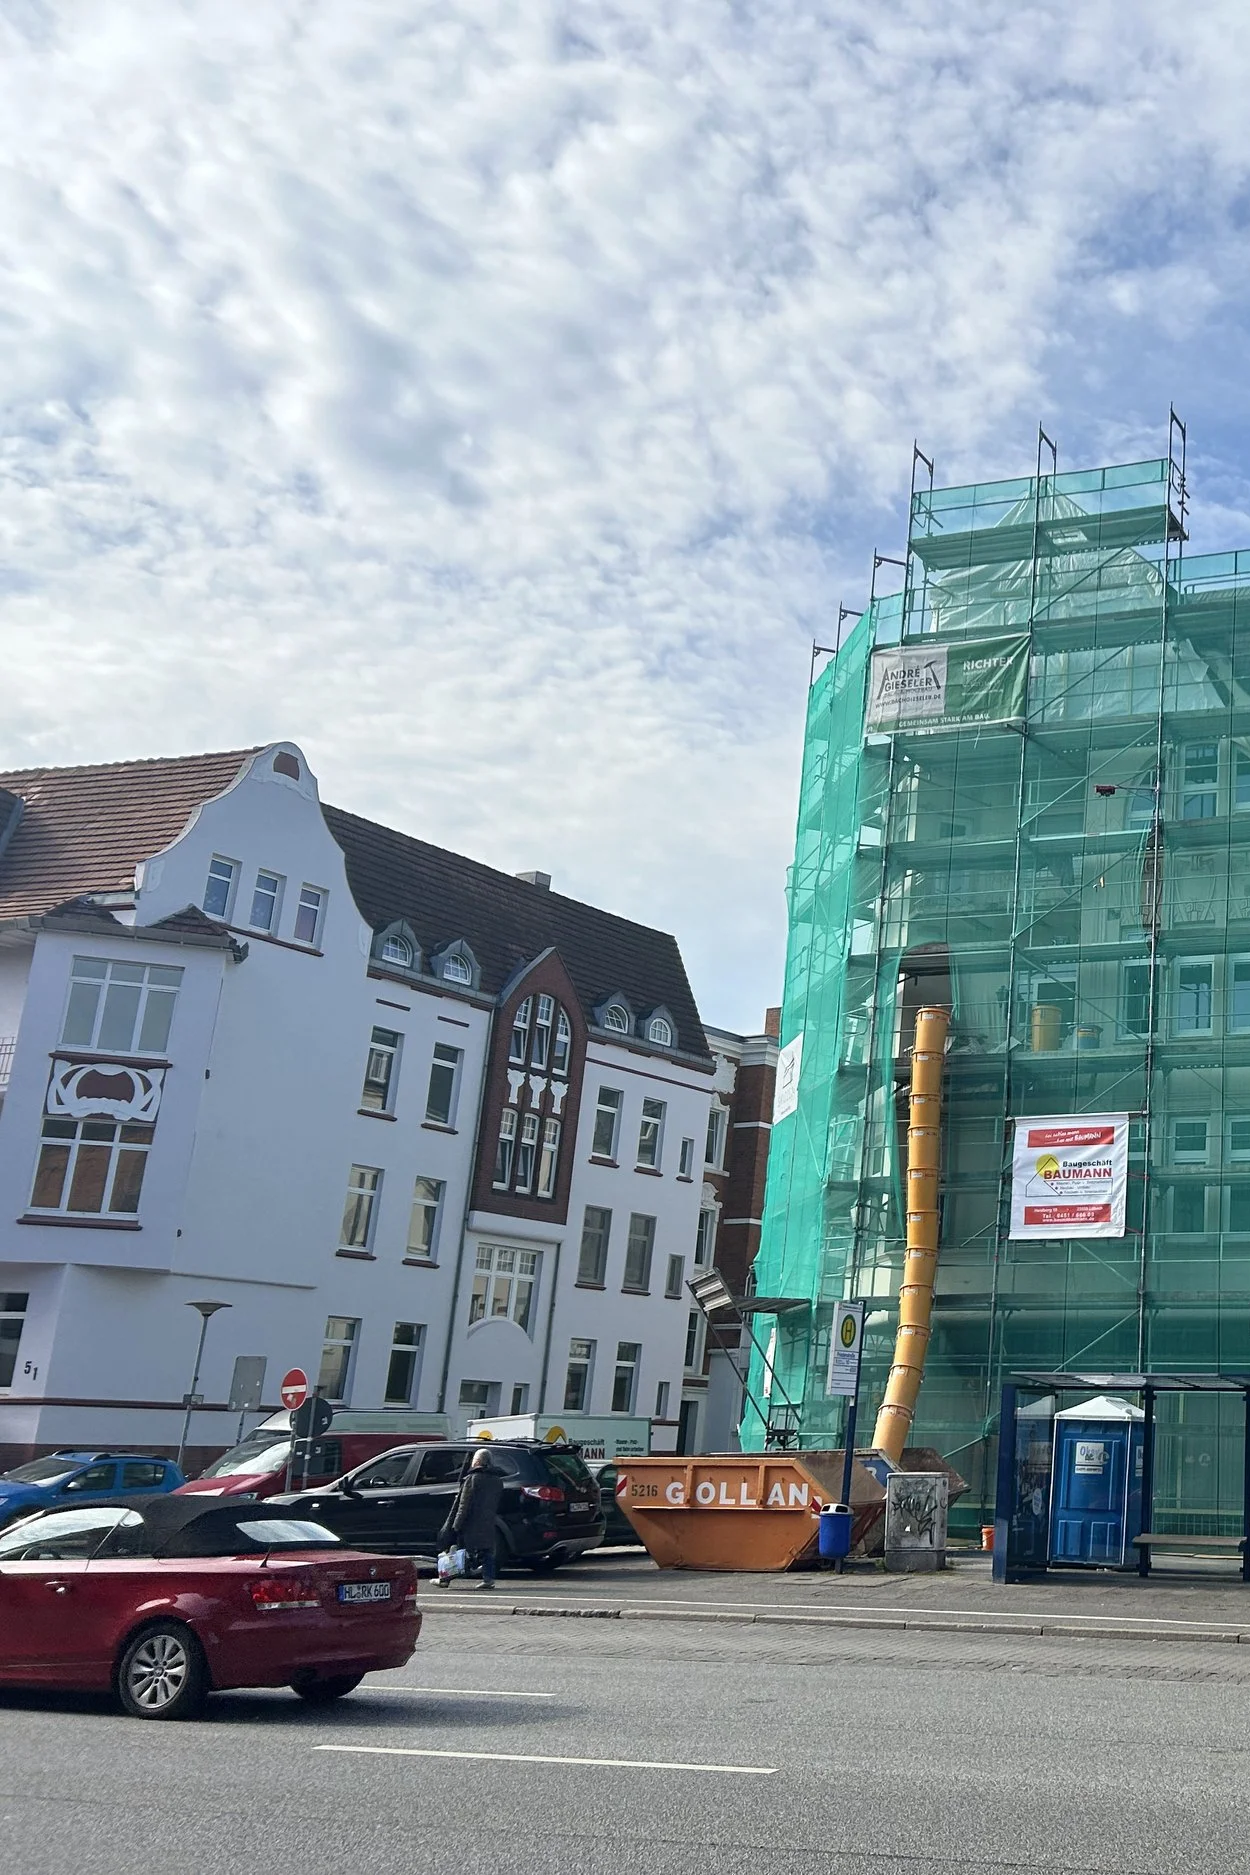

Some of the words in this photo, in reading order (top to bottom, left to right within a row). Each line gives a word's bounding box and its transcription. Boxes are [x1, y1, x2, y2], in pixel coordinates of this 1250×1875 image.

[963, 656, 1013, 670] RICHTER
[884, 677, 932, 692] GIESELER
[899, 718, 939, 727] GEMEINSAM
[941, 715, 960, 723] STARK
[1062, 1160, 1112, 1168] Baugeschäft
[1043, 1168, 1112, 1180] BAUMANN
[24, 1360, 38, 1381] 51
[631, 1484, 658, 1497] 5216
[665, 1481, 809, 1506] GOLLAN
[374, 1584, 390, 1597] 600
